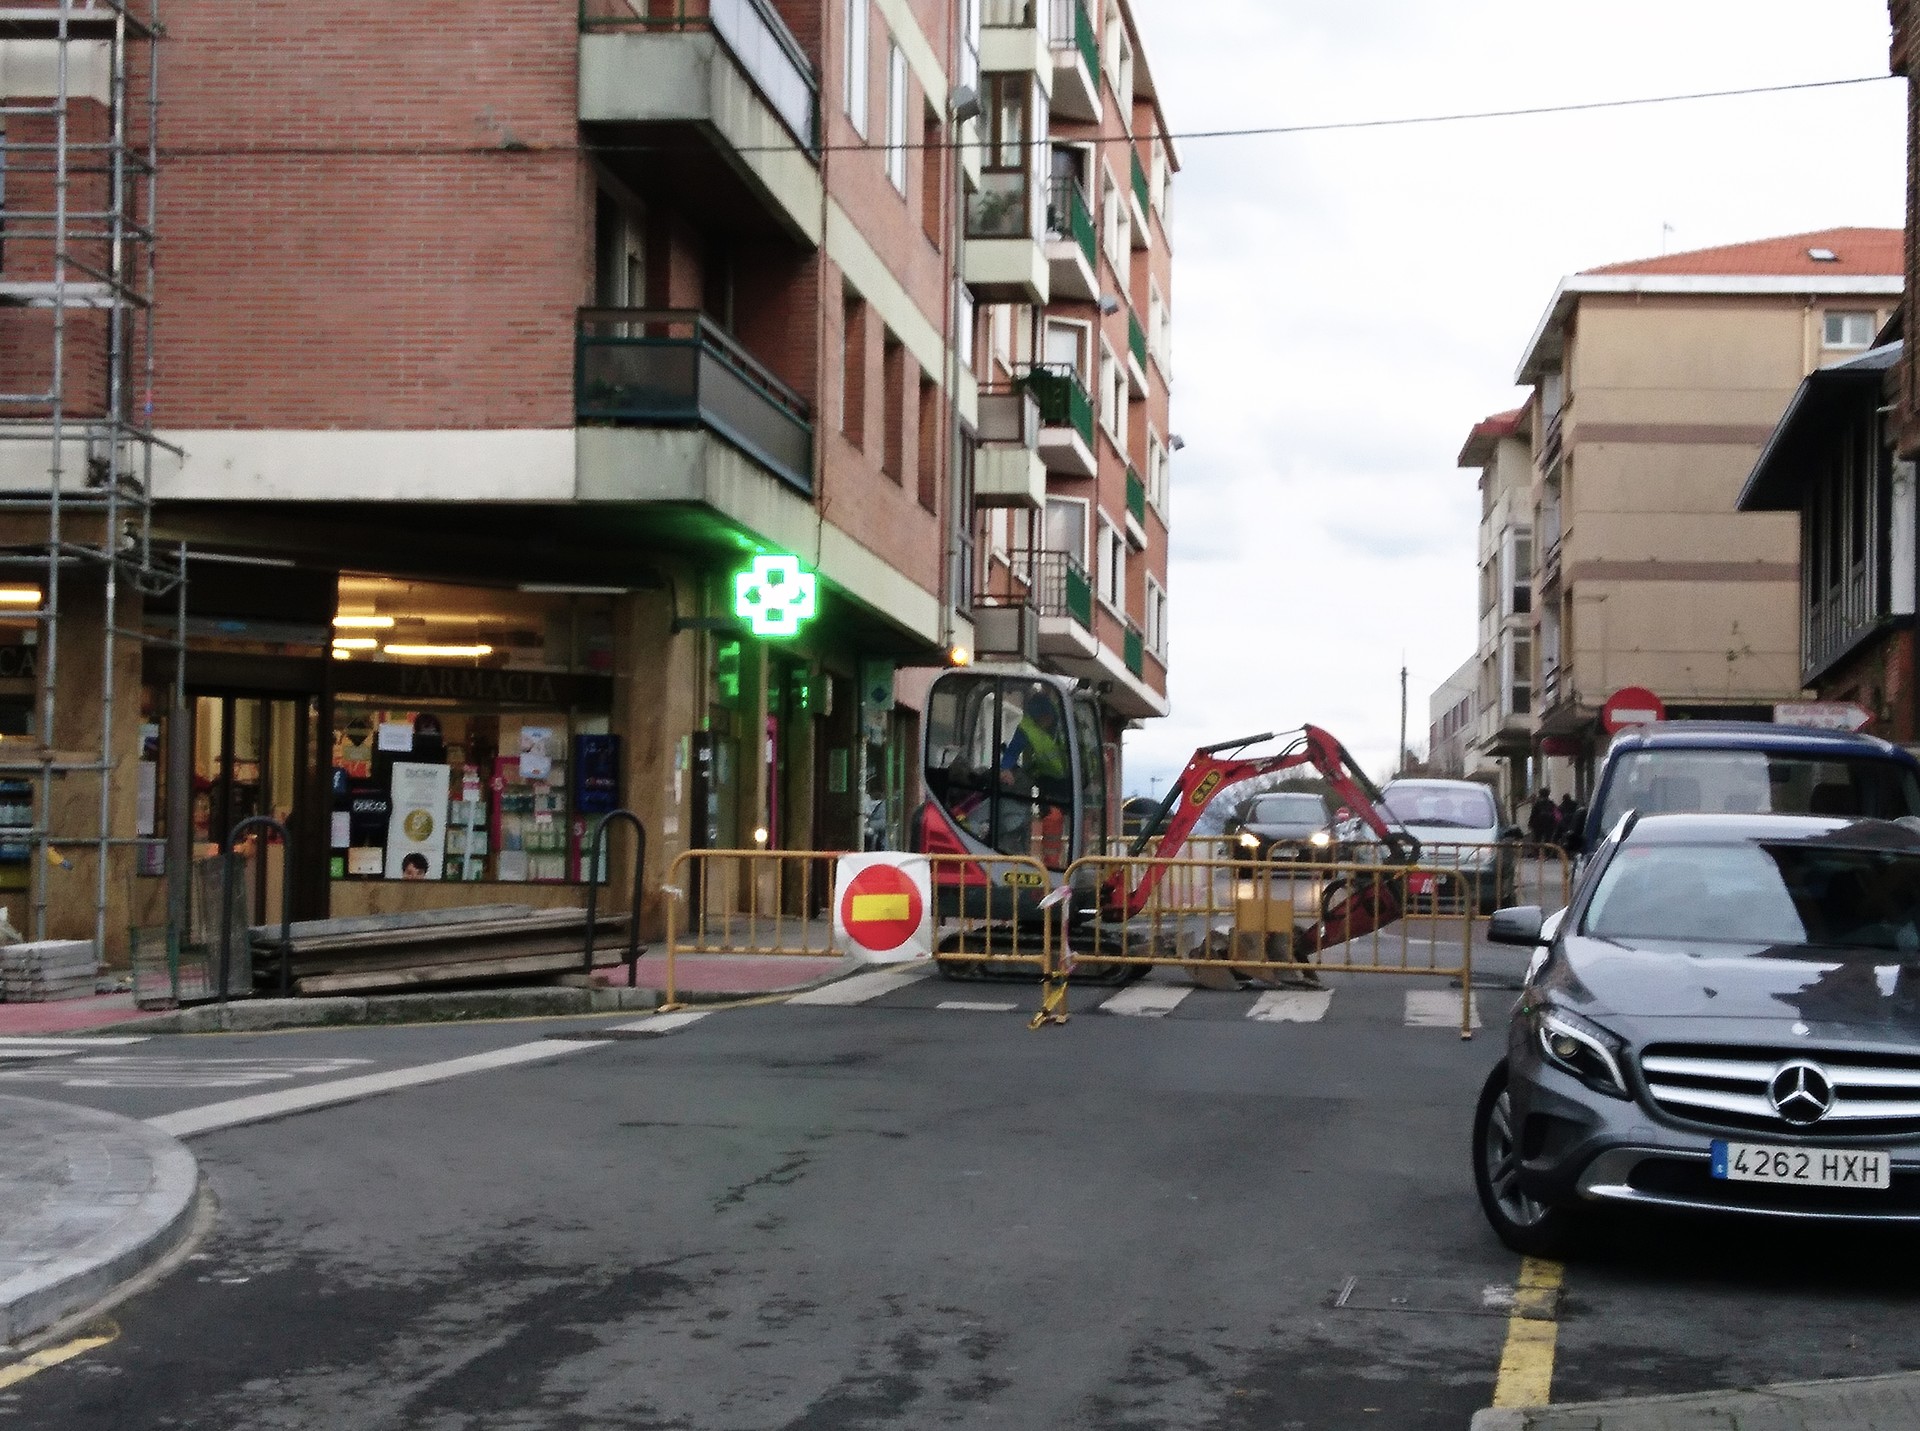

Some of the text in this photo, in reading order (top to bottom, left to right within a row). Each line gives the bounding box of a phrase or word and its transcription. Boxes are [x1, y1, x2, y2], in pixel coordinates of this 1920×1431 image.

[399, 668, 558, 701] FARMACIA
[1735, 1149, 1810, 1178] 4262
[1822, 1154, 1879, 1182] HXH
